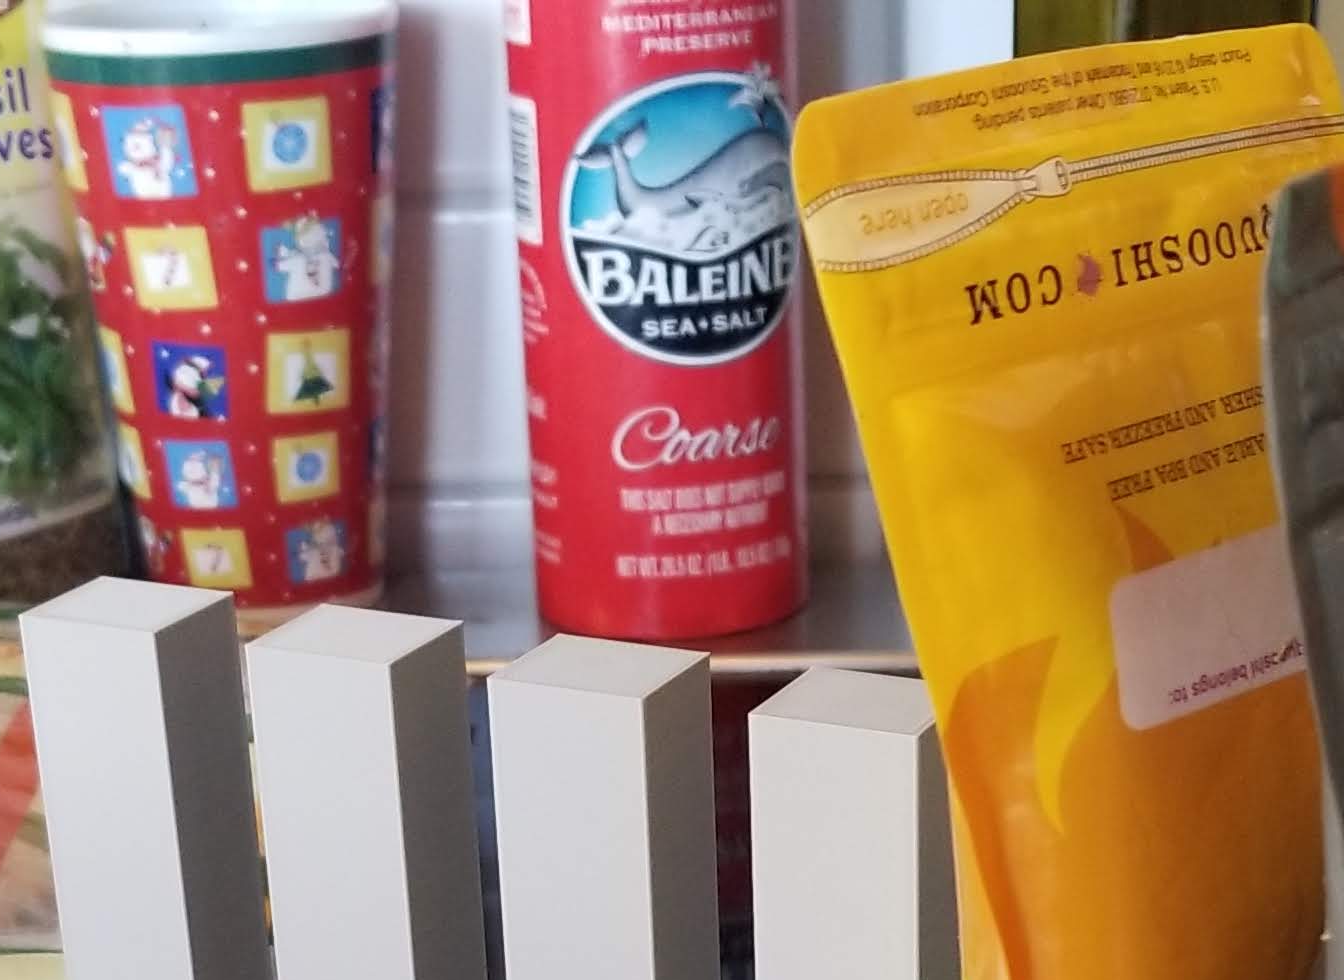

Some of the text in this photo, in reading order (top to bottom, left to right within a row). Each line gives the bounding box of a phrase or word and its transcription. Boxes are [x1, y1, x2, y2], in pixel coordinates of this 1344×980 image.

[641, 30, 752, 53] PRESERVE
[858, 191, 969, 236] open here
[1185, 400, 1217, 427] AND
[611, 405, 780, 472] Coarse
[1108, 411, 1184, 449] FREEZER
[1061, 433, 1109, 465] SAFE
[1189, 448, 1222, 475] AND
[1107, 469, 1155, 502] FREE
[1154, 459, 1189, 485] BPA
[1191, 663, 1249, 697] belongs
